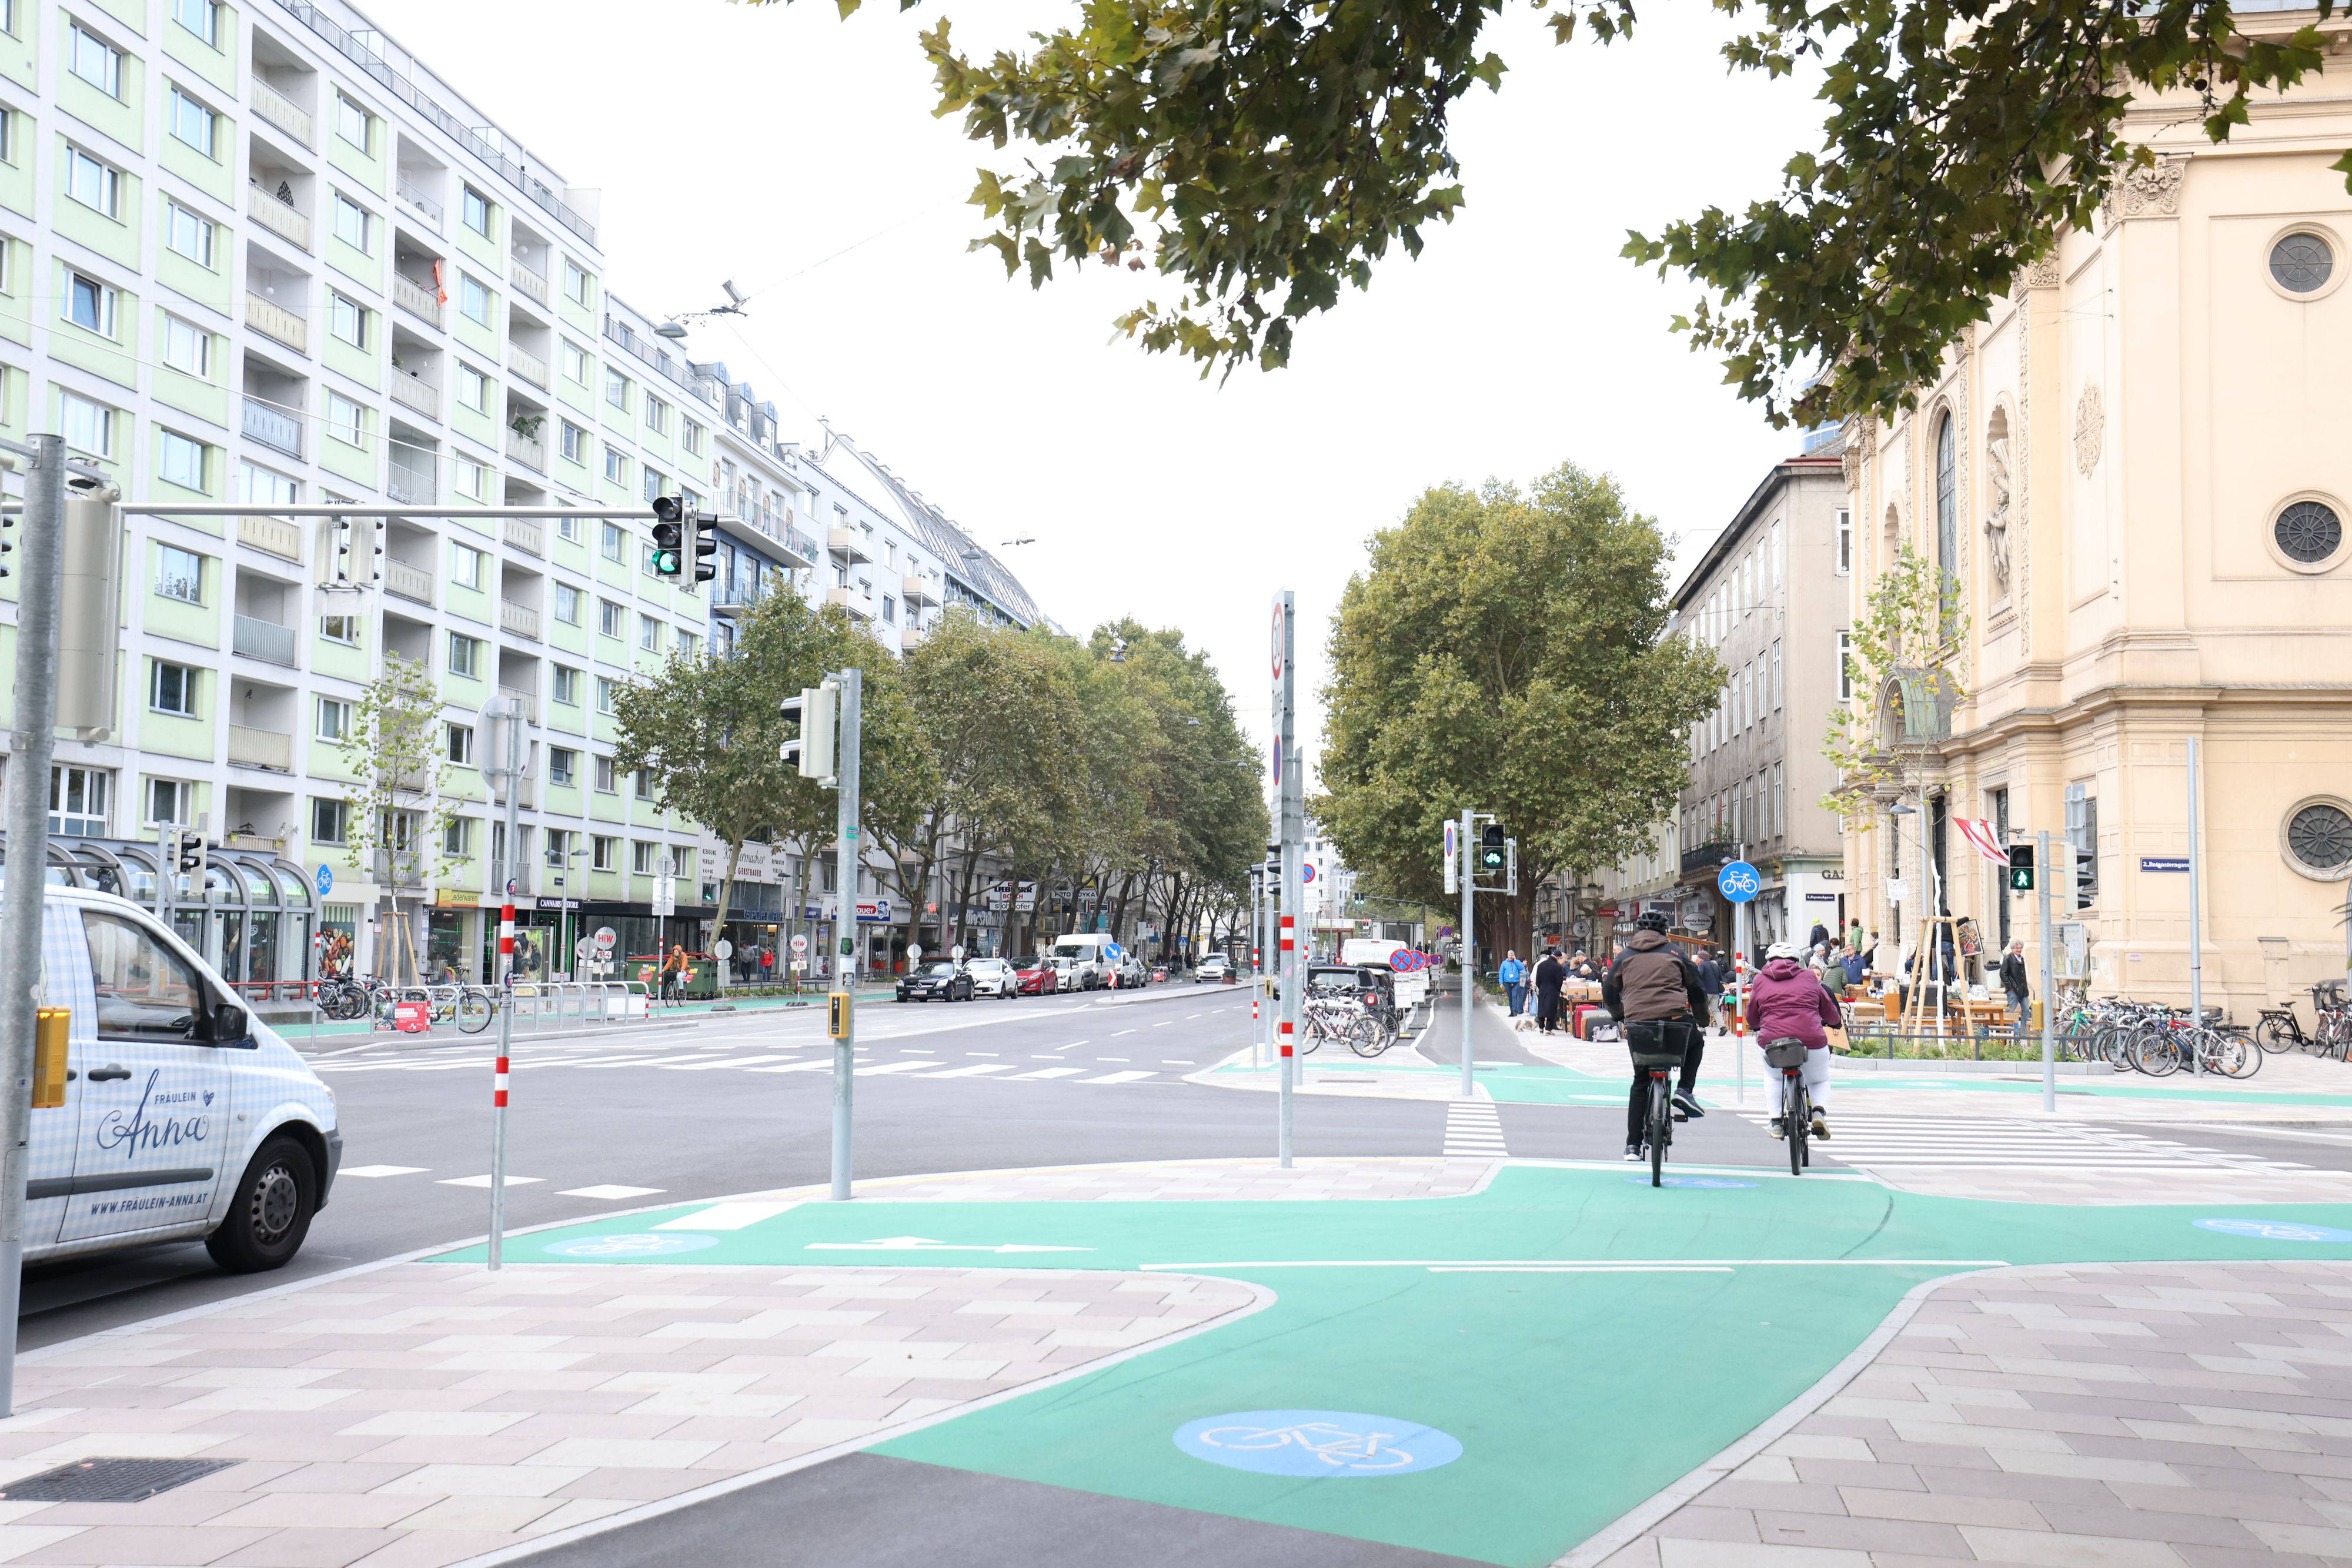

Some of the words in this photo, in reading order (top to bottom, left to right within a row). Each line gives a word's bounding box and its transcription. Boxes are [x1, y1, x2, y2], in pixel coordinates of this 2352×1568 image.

[540, 900, 562, 908] CANNABIS
[154, 1091, 197, 1105] FRÄULEIN
[96, 1068, 209, 1159] Anna
[91, 1192, 208, 1216] WWW.FRÄULEIN-ANNA.AT
